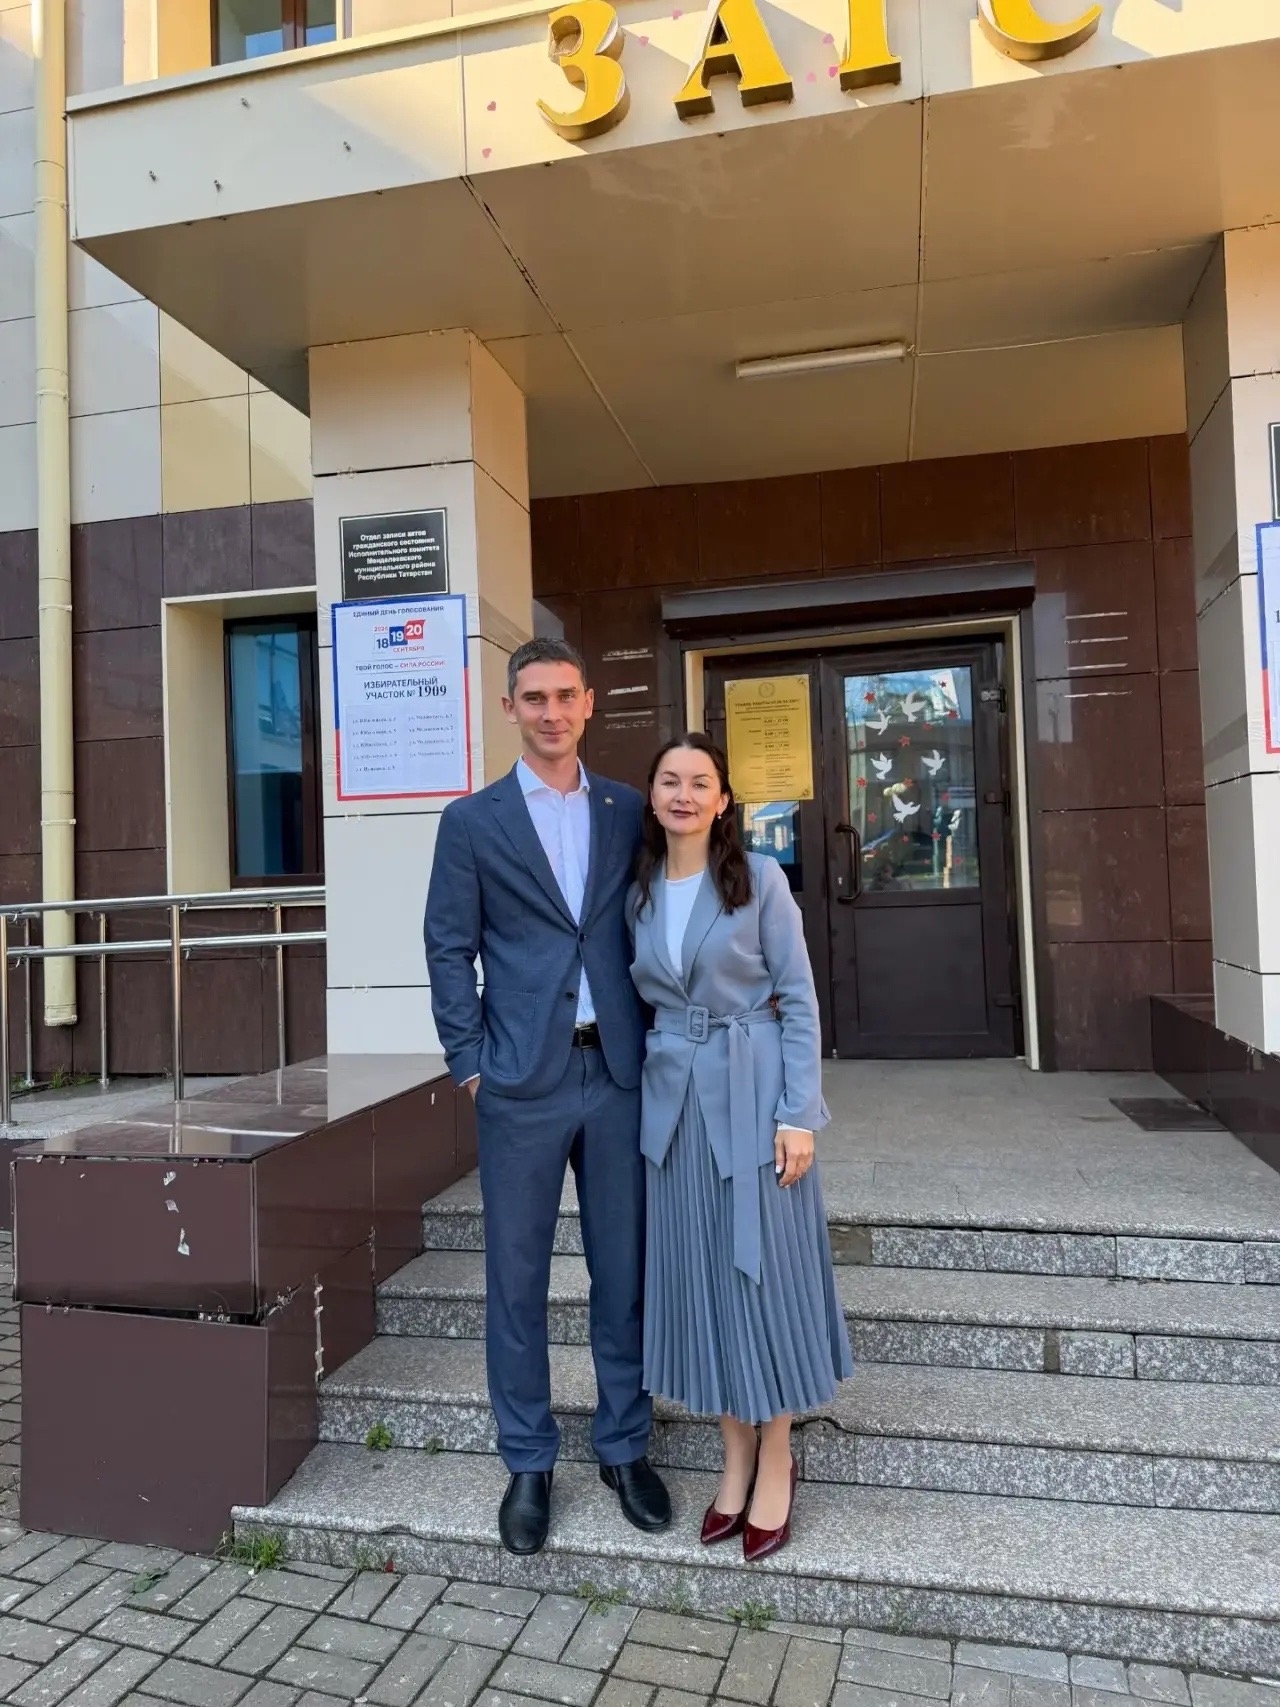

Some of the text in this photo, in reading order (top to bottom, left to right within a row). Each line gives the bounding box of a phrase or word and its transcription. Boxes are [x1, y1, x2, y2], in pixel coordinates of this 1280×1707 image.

[348, 545, 440, 558] Исполнительного комитета
[352, 541, 398, 550] гражданского
[354, 561, 436, 574] муниципального района
[357, 569, 433, 581] Республики Татарстан
[353, 606, 444, 617] ЕДИНЫЙ ДЕНЬ ГОЛОСОВАНИЯ
[391, 631, 404, 642] 19
[406, 624, 422, 637] 20
[376, 638, 389, 649] 18
[363, 676, 438, 689] ИЗБИРАТЕЛЬНЫЙ
[365, 690, 405, 700] УЧАСТОК
[418, 684, 447, 697] 1909
